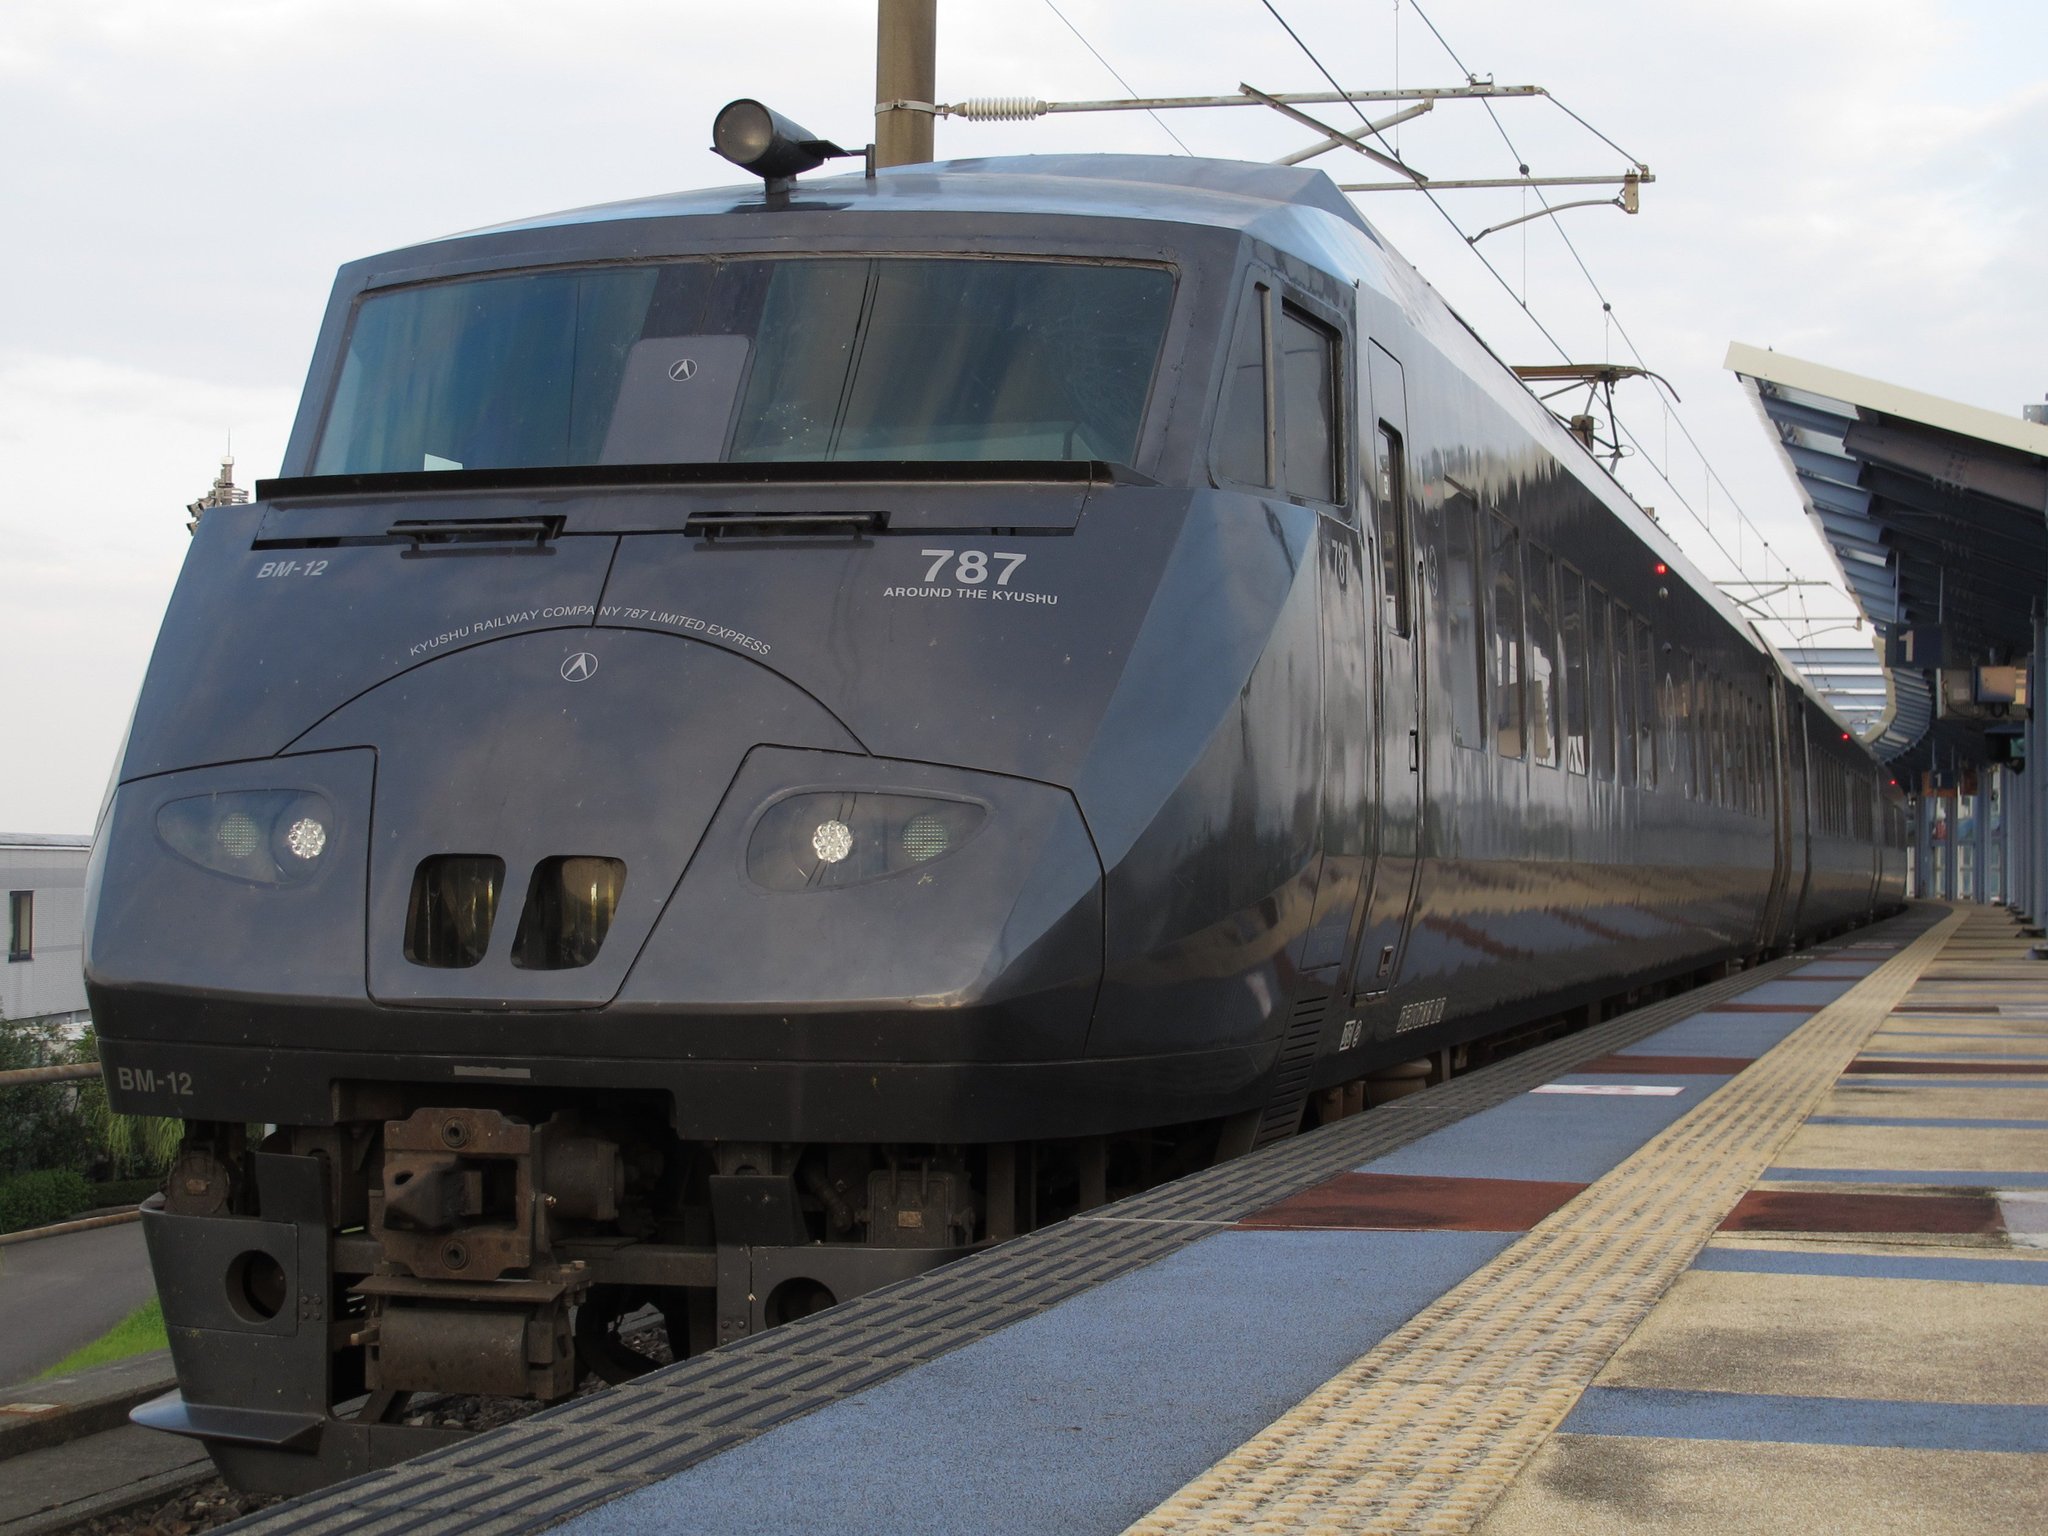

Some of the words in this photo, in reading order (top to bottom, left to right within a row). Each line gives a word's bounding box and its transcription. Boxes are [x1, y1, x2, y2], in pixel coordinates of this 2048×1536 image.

[256, 560, 329, 579] BM-12
[921, 549, 1027, 586] 787
[1331, 539, 1349, 586] 787
[883, 587, 952, 598] AROUND
[956, 588, 988, 600] THE
[992, 590, 1058, 605] KYUSHU
[410, 626, 470, 657] KYUSHU
[473, 609, 540, 633] RAILWAY
[542, 605, 622, 619] COMPANY
[623, 606, 649, 620] 787
[649, 610, 706, 632] LIMITED
[706, 622, 772, 656] EXPRESS
[1898, 630, 1914, 662] 1
[117, 1067, 194, 1095] BM-12
